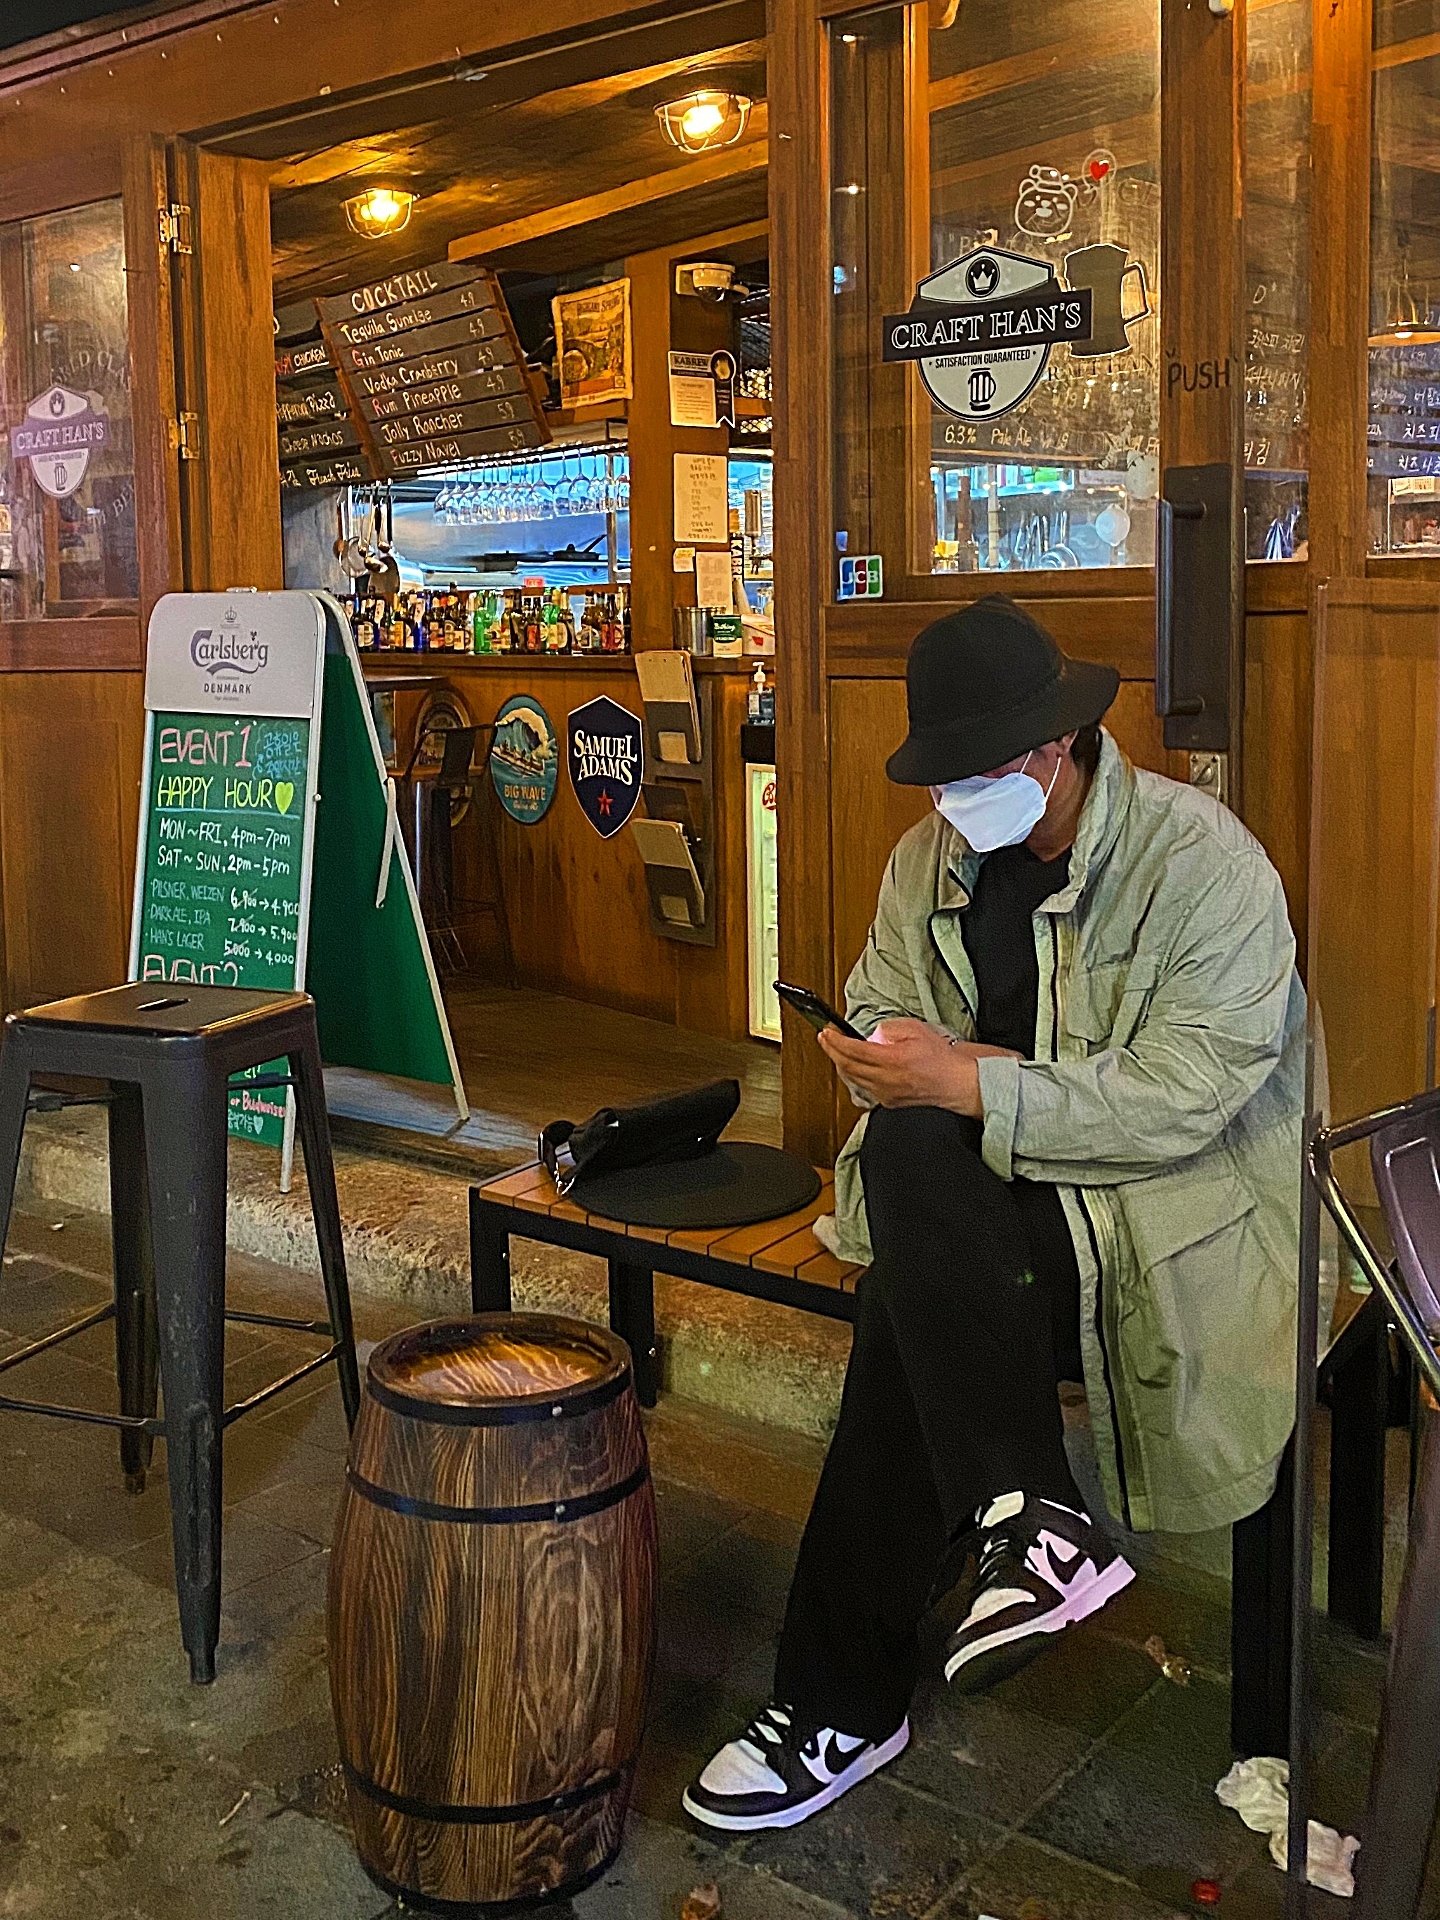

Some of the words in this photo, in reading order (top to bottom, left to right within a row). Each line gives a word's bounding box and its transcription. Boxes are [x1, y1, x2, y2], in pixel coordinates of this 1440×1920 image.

[351, 270, 437, 312] COCKTAIL
[341, 322, 385, 343] Tequila
[386, 308, 432, 332] Sunrise
[891, 316, 984, 349] CRAFT
[989, 303, 1081, 338] HAN'S
[294, 345, 325, 366] CHICKEN
[352, 349, 376, 367] Gin
[377, 345, 404, 364] Tonic
[935, 354, 983, 368] SATISFACTION
[984, 349, 1030, 365] GUARANTEED
[364, 371, 398, 395] Vodka
[400, 358, 459, 386] Cranberry
[1167, 358, 1230, 398] PUSH
[372, 398, 398, 417] Rum
[403, 383, 462, 413] Pineapple
[16, 428, 59, 450] CRAFT
[62, 421, 104, 444] HAN'S
[382, 421, 409, 444] Jolly
[413, 412, 463, 435] Rancher
[945, 425, 976, 444] 6.3%
[991, 428, 1011, 446] Pale
[1014, 427, 1031, 447] Ale
[390, 448, 422, 466] Fuzzy
[425, 441, 461, 463] Navel
[730, 539, 743, 583] KABRE
[842, 570, 879, 585] JCB
[191, 629, 268, 674] Carlsberg
[204, 682, 252, 694] DENMARK
[160, 727, 234, 766] EVENT
[574, 729, 637, 762] SAMUEL
[577, 756, 633, 786] ADAMS
[158, 775, 213, 810] HAPPY
[225, 777, 272, 808] HOUR
[504, 784, 519, 799] BIG
[521, 785, 546, 801] WAVE
[191, 885, 224, 902] WEIZEN
[150, 904, 172, 921] DARK
[194, 909, 210, 925] IPA
[177, 933, 204, 951] LAGER
